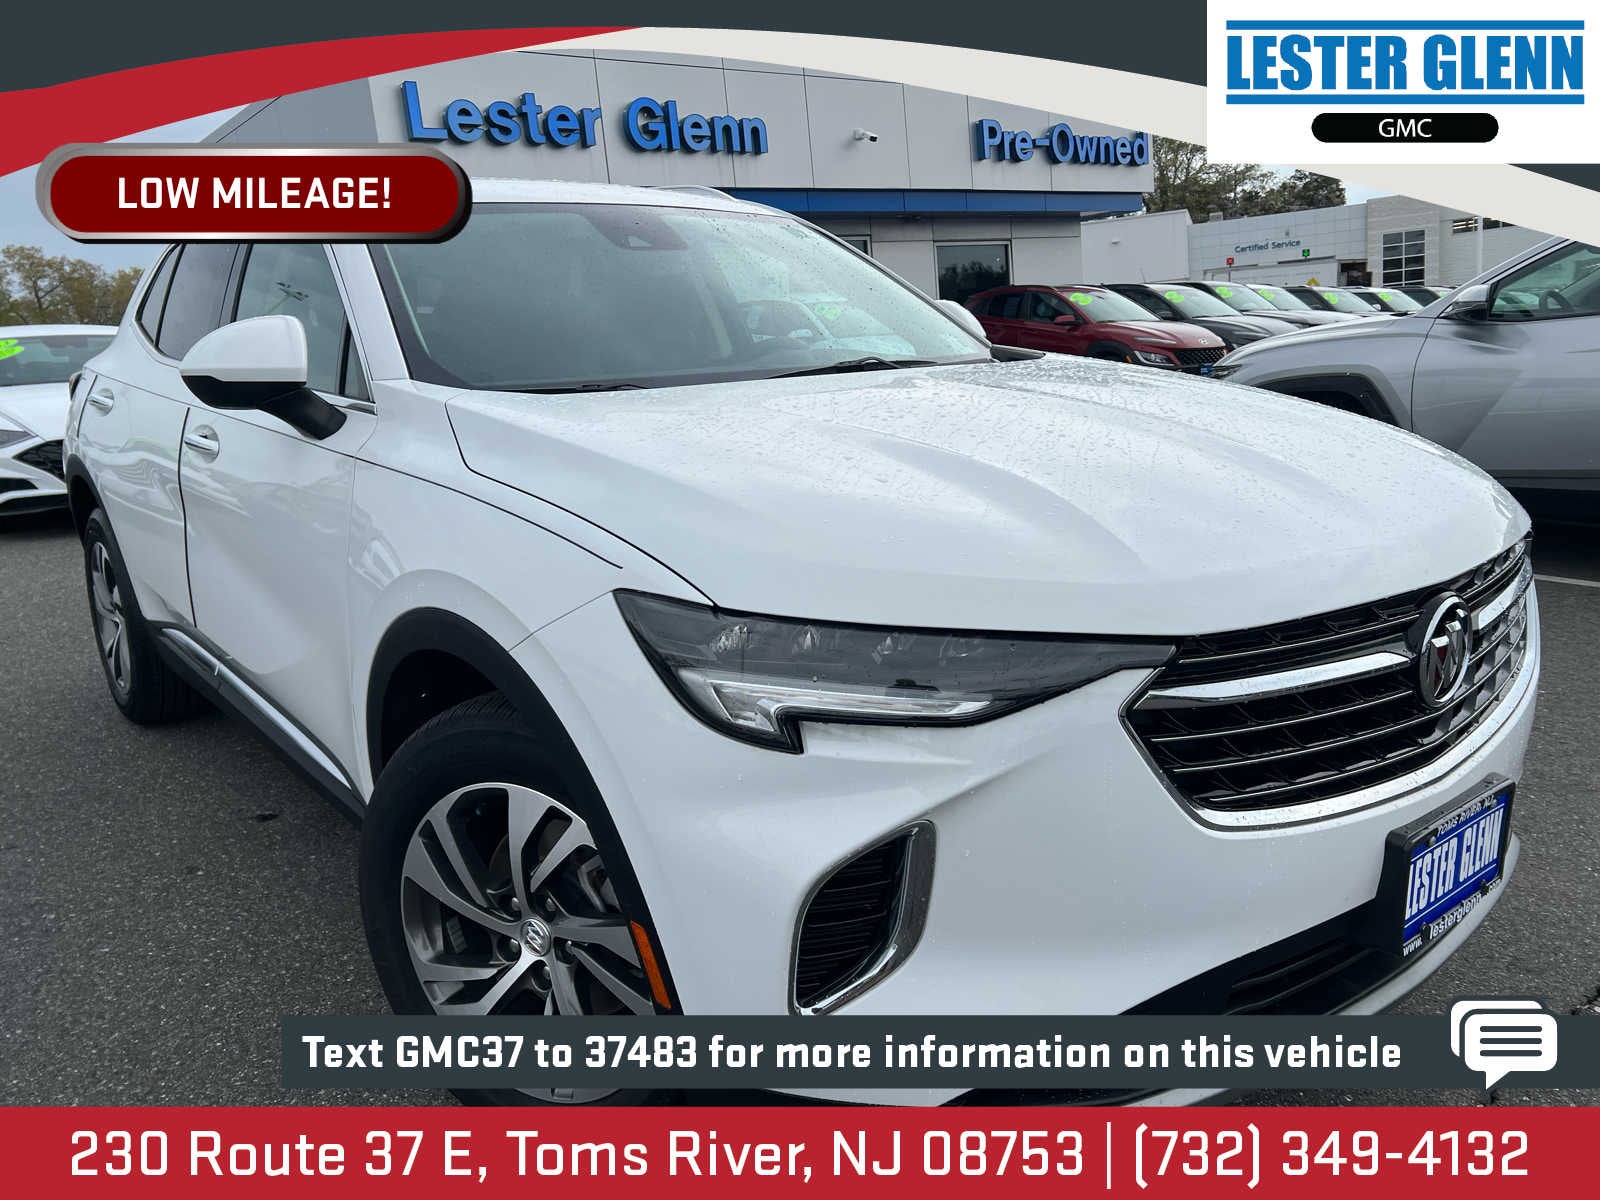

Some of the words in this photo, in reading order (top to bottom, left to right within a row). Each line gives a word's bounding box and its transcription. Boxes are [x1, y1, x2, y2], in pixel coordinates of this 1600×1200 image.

[400, 80, 602, 147] Lester
[623, 96, 769, 155] Glenn
[975, 118, 1149, 165] Pre-Owned
[1234, 242, 1269, 254] Certified
[1271, 239, 1301, 249] Service
[1459, 809, 1503, 882] GLENN
